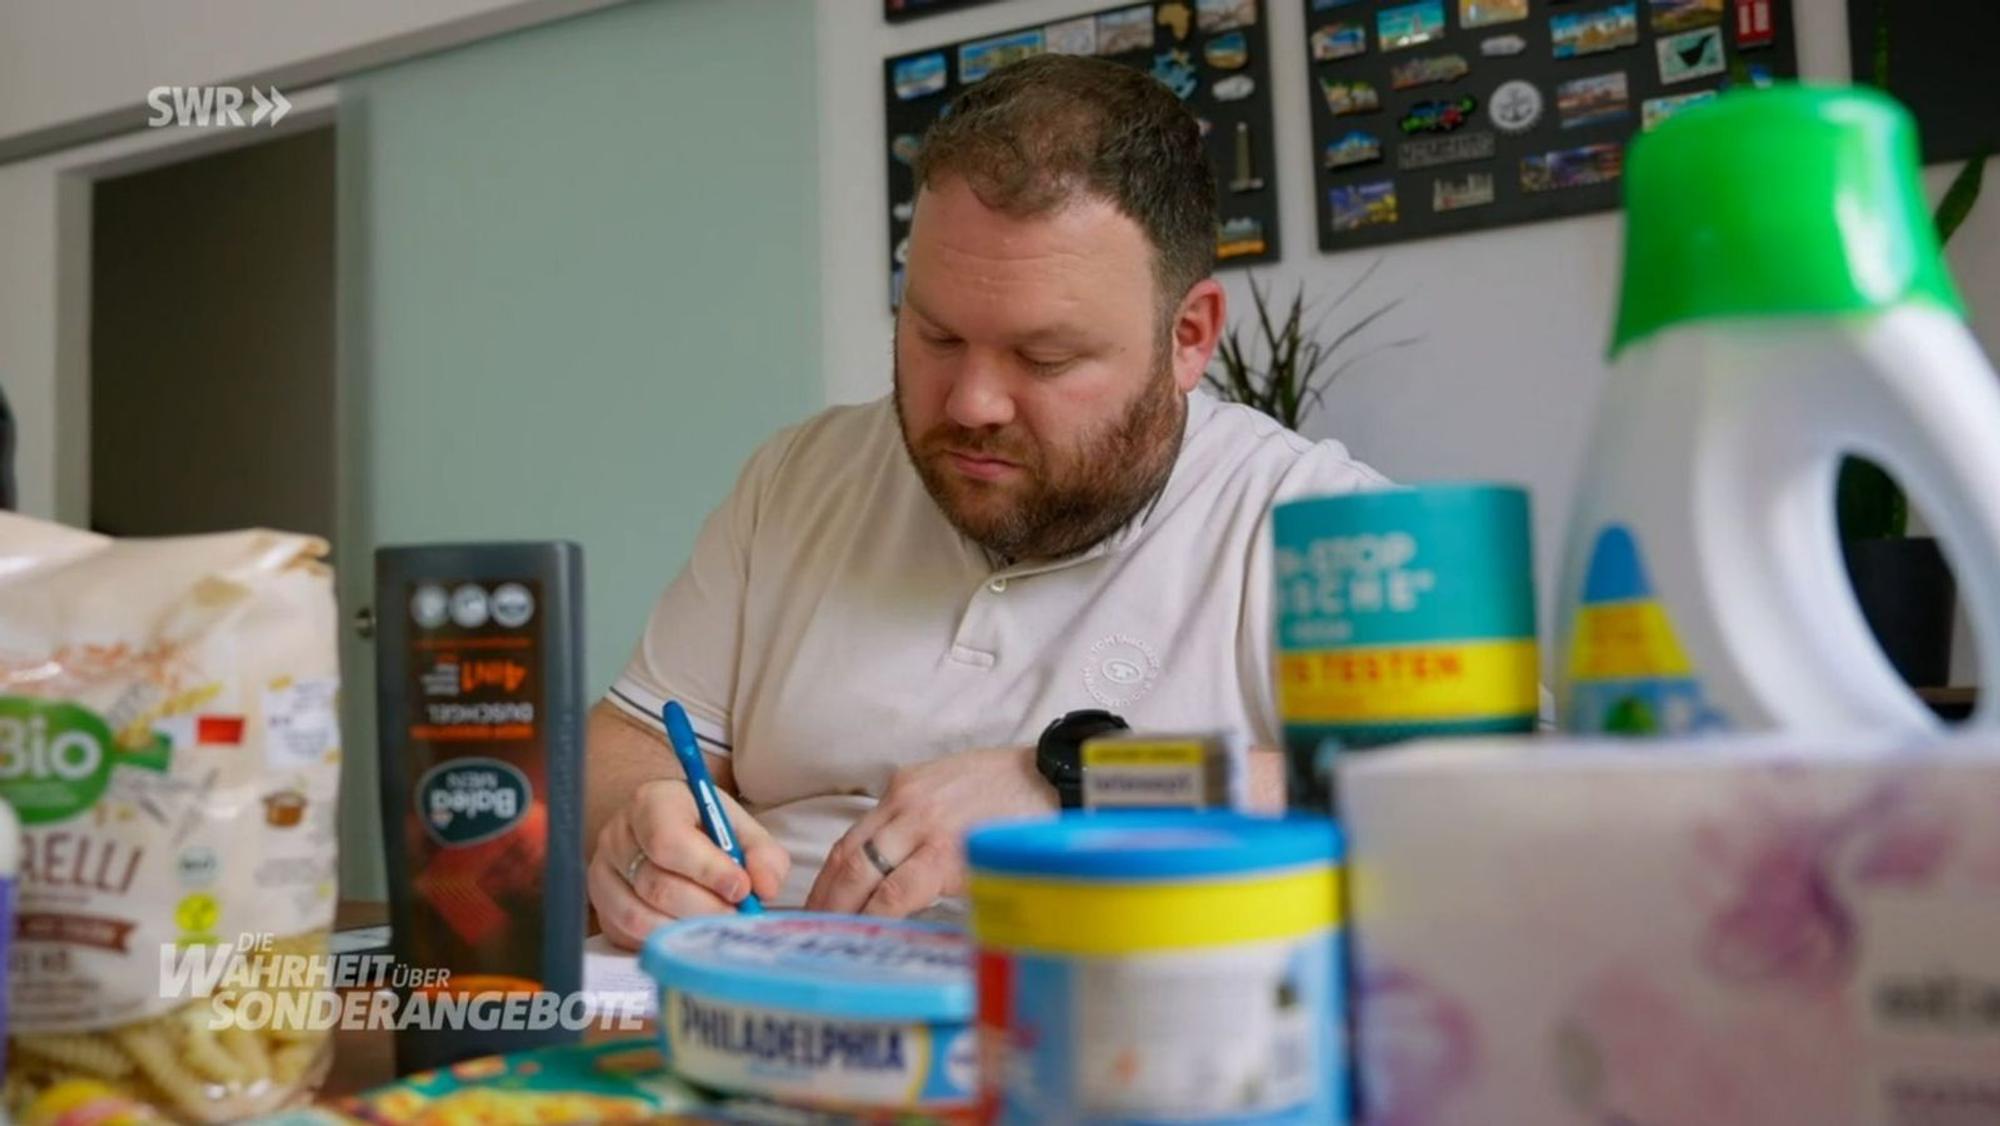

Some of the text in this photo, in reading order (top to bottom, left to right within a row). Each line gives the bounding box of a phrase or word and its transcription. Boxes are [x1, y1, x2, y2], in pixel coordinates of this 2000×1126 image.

[426, 702, 534, 724] DUSCHGEL
[0, 713, 102, 781] Bio
[430, 788, 517, 820] Balea
[680, 993, 906, 1071] PHILADELPHIA
